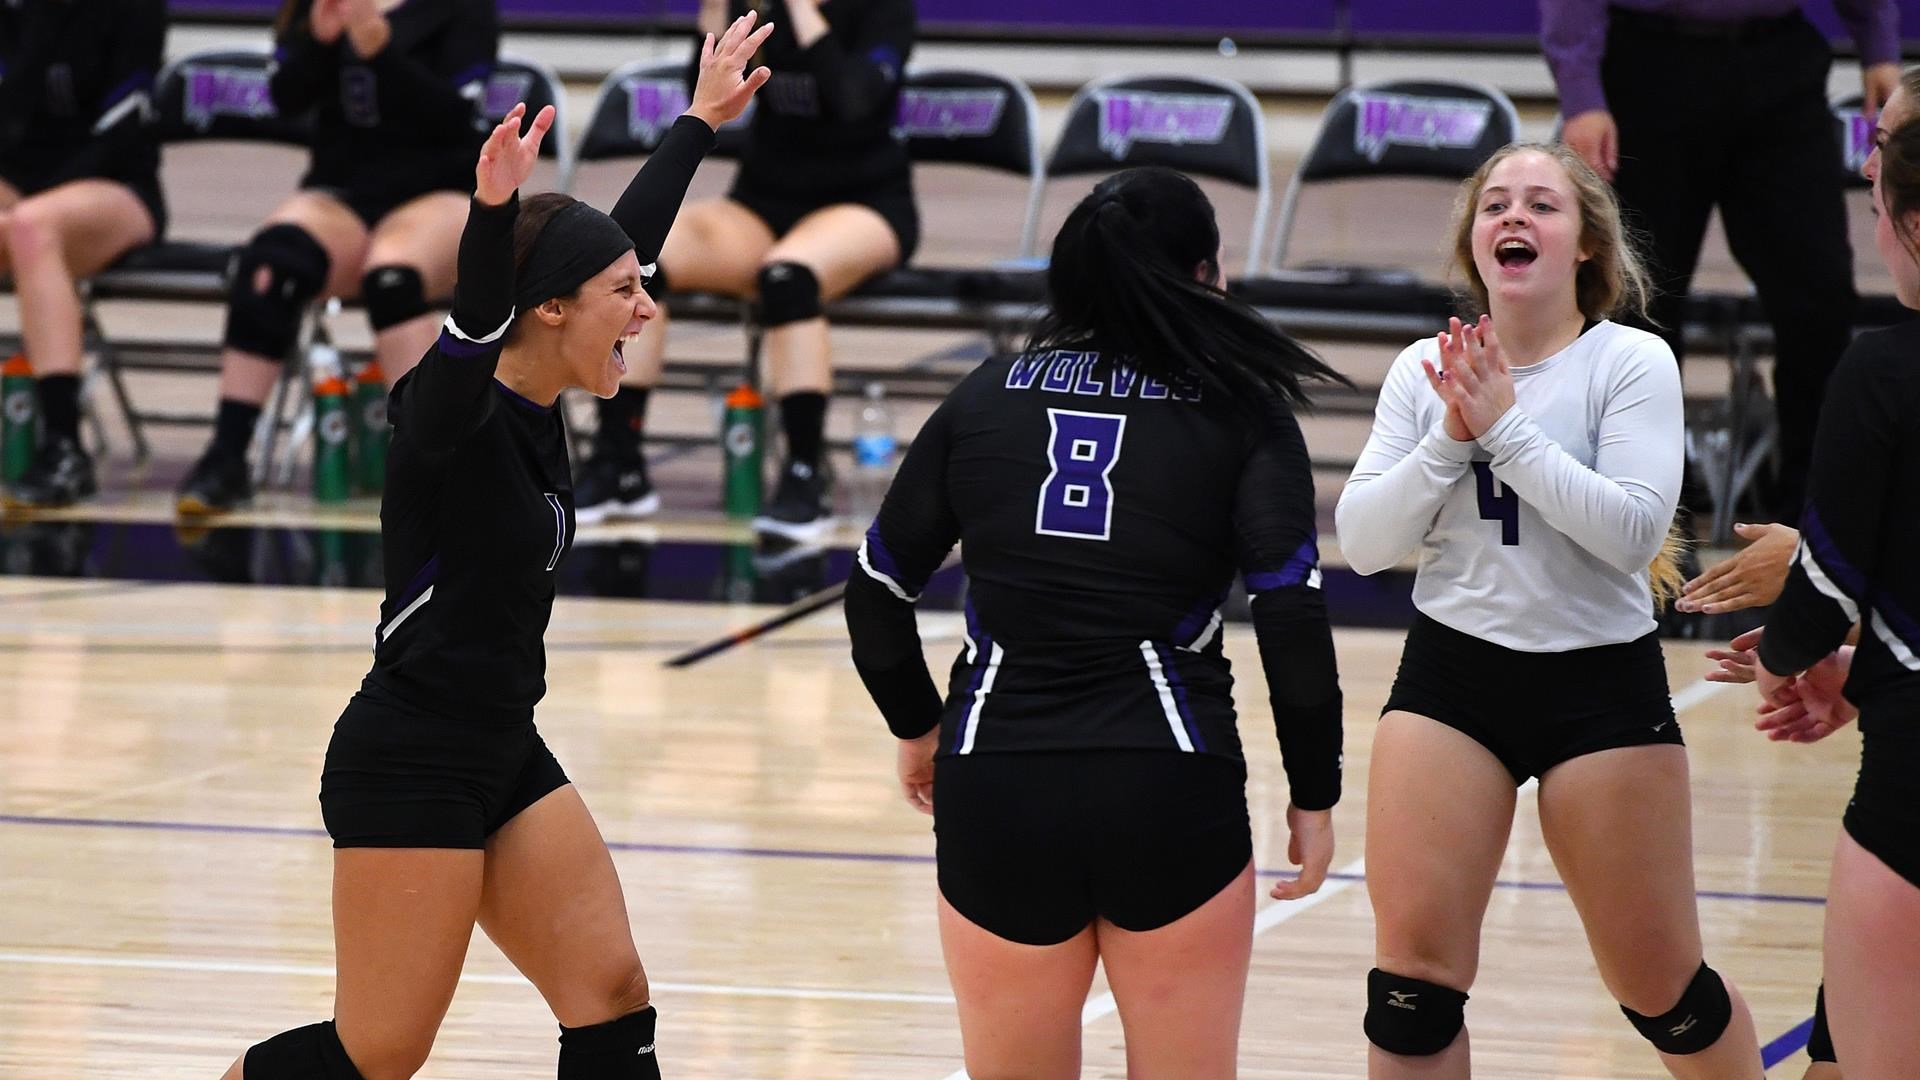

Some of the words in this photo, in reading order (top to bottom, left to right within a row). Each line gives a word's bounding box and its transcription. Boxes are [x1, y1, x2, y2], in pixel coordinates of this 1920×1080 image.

[1036, 407, 1127, 541] 8
[1471, 461, 1519, 546] 4
[543, 492, 566, 571] 1
